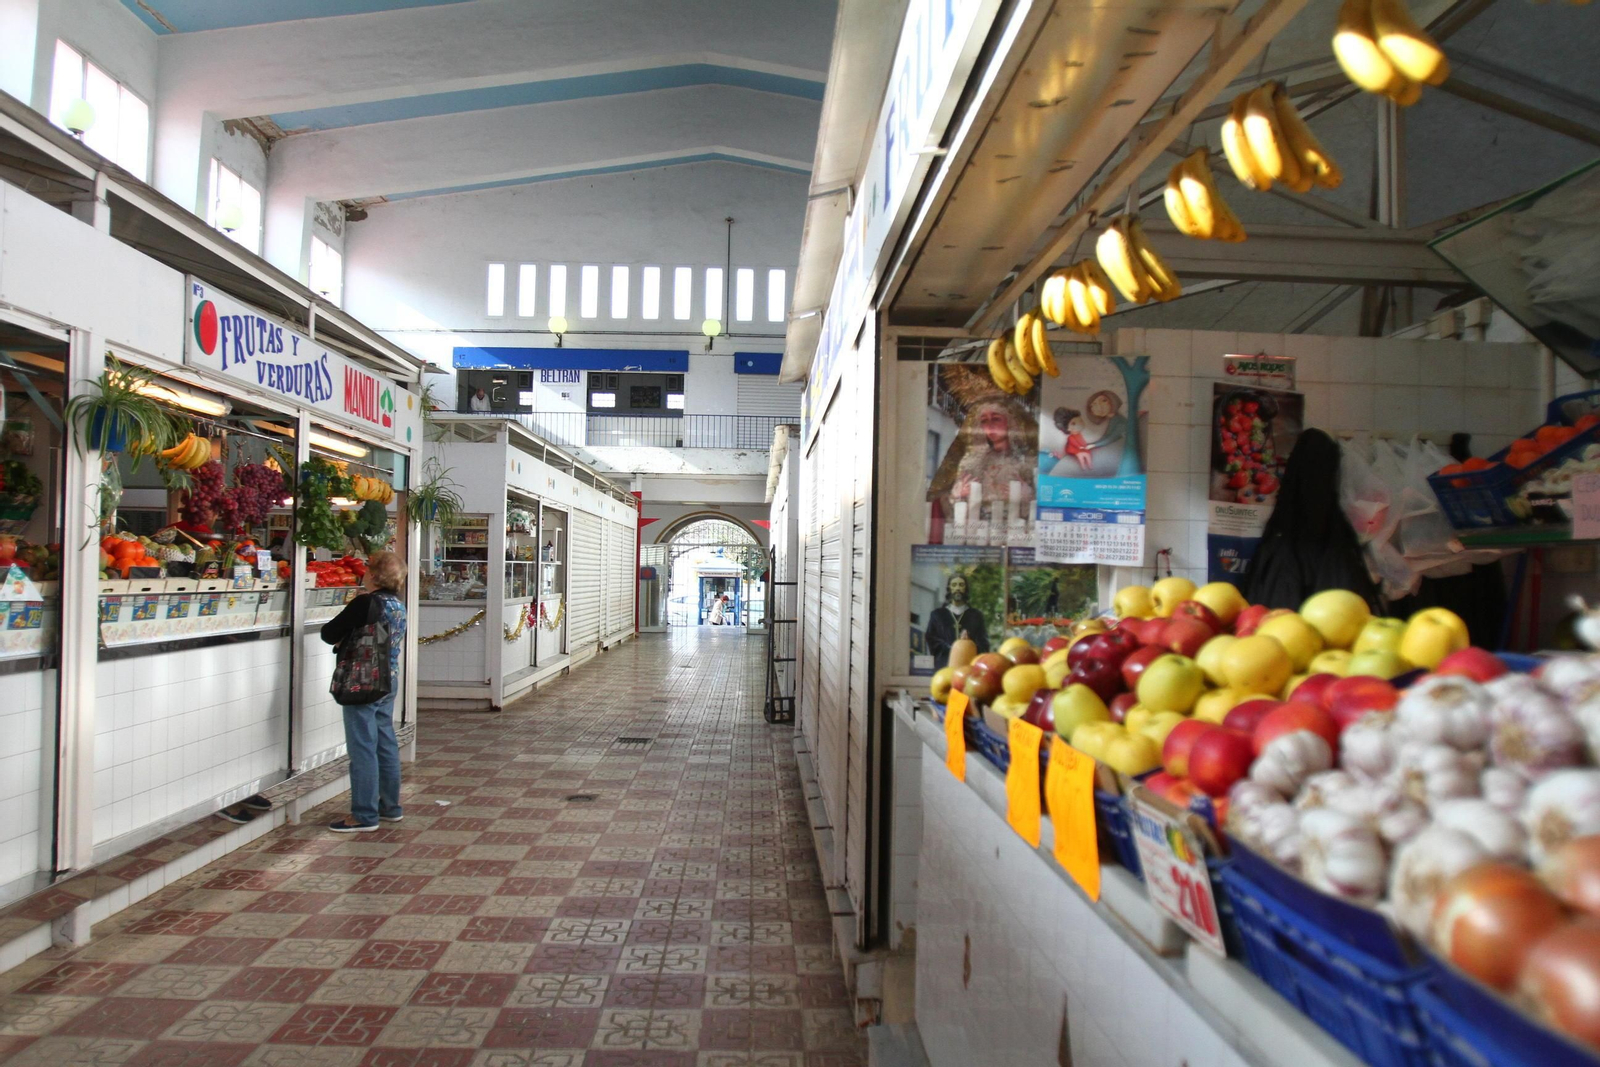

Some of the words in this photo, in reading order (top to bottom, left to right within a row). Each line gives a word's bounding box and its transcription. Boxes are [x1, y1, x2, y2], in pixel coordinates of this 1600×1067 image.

[220, 315, 284, 371] FRUTAS
[292, 335, 300, 356] Y
[256, 352, 332, 404] VERDURAS
[344, 364, 380, 424] MANOLI
[541, 369, 580, 382] BELTRAN
